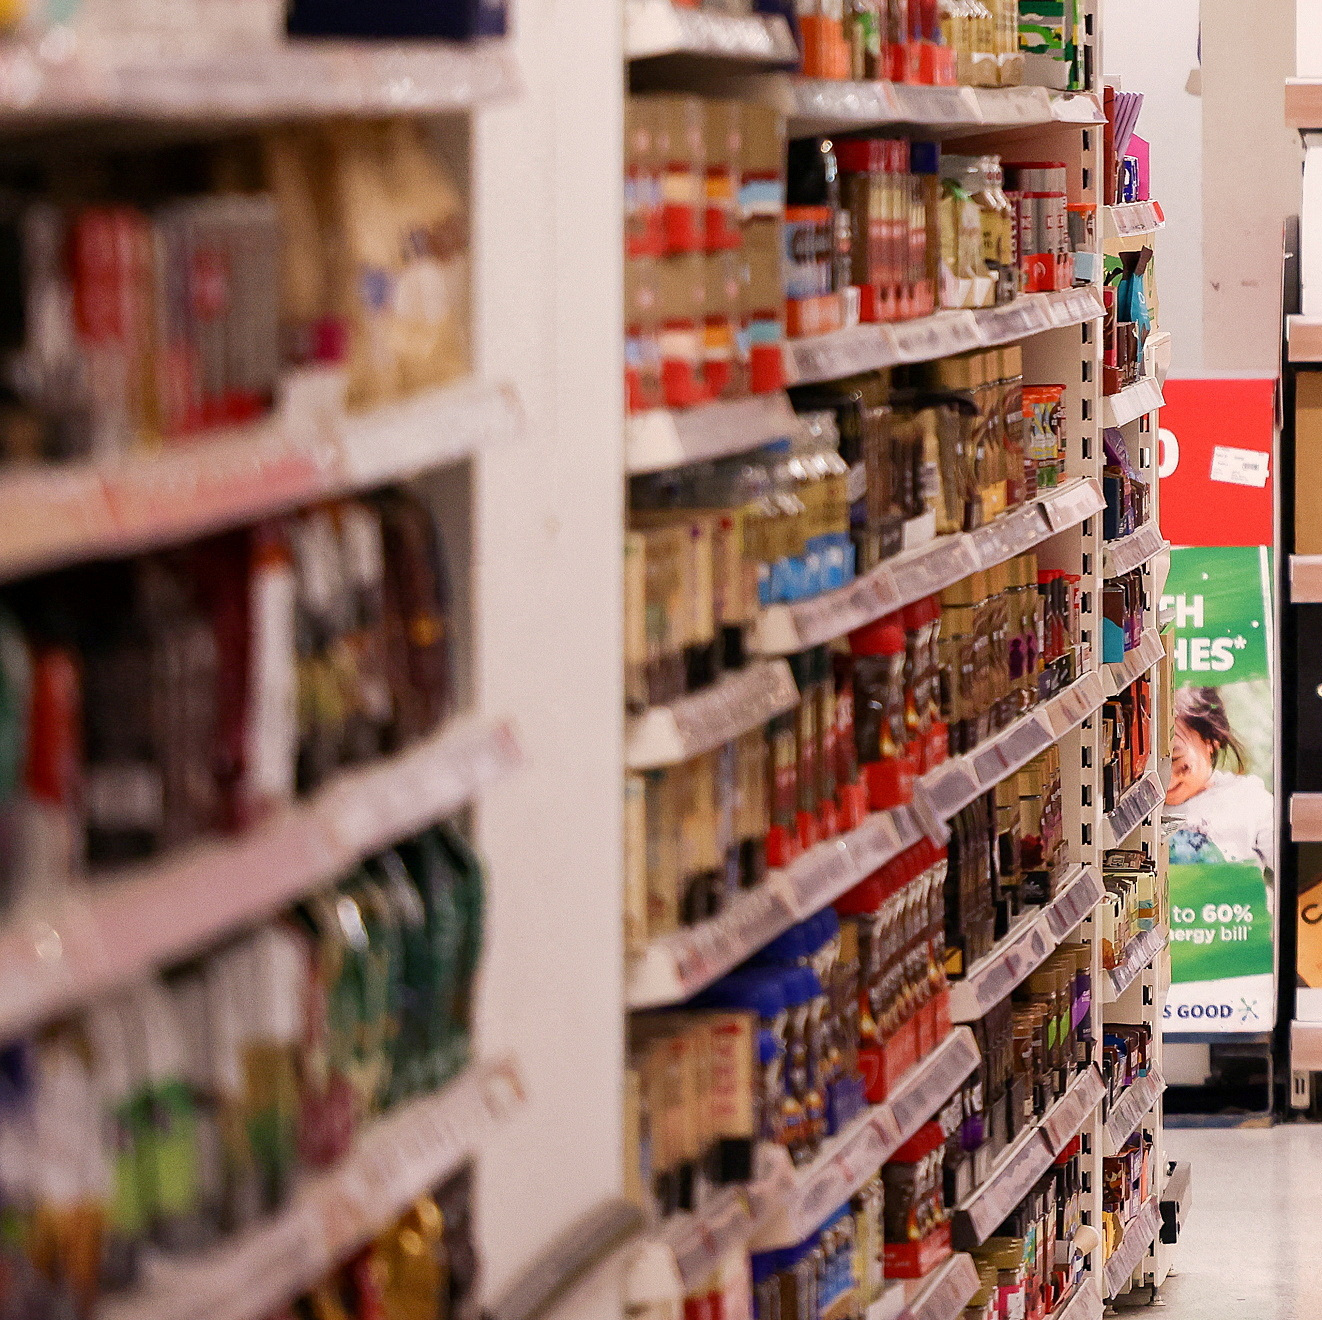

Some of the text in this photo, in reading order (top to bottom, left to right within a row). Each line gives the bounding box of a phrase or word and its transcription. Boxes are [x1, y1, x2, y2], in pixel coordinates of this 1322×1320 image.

[1171, 903, 1254, 923] to 60%
[1177, 1004, 1234, 1019] GOOD
